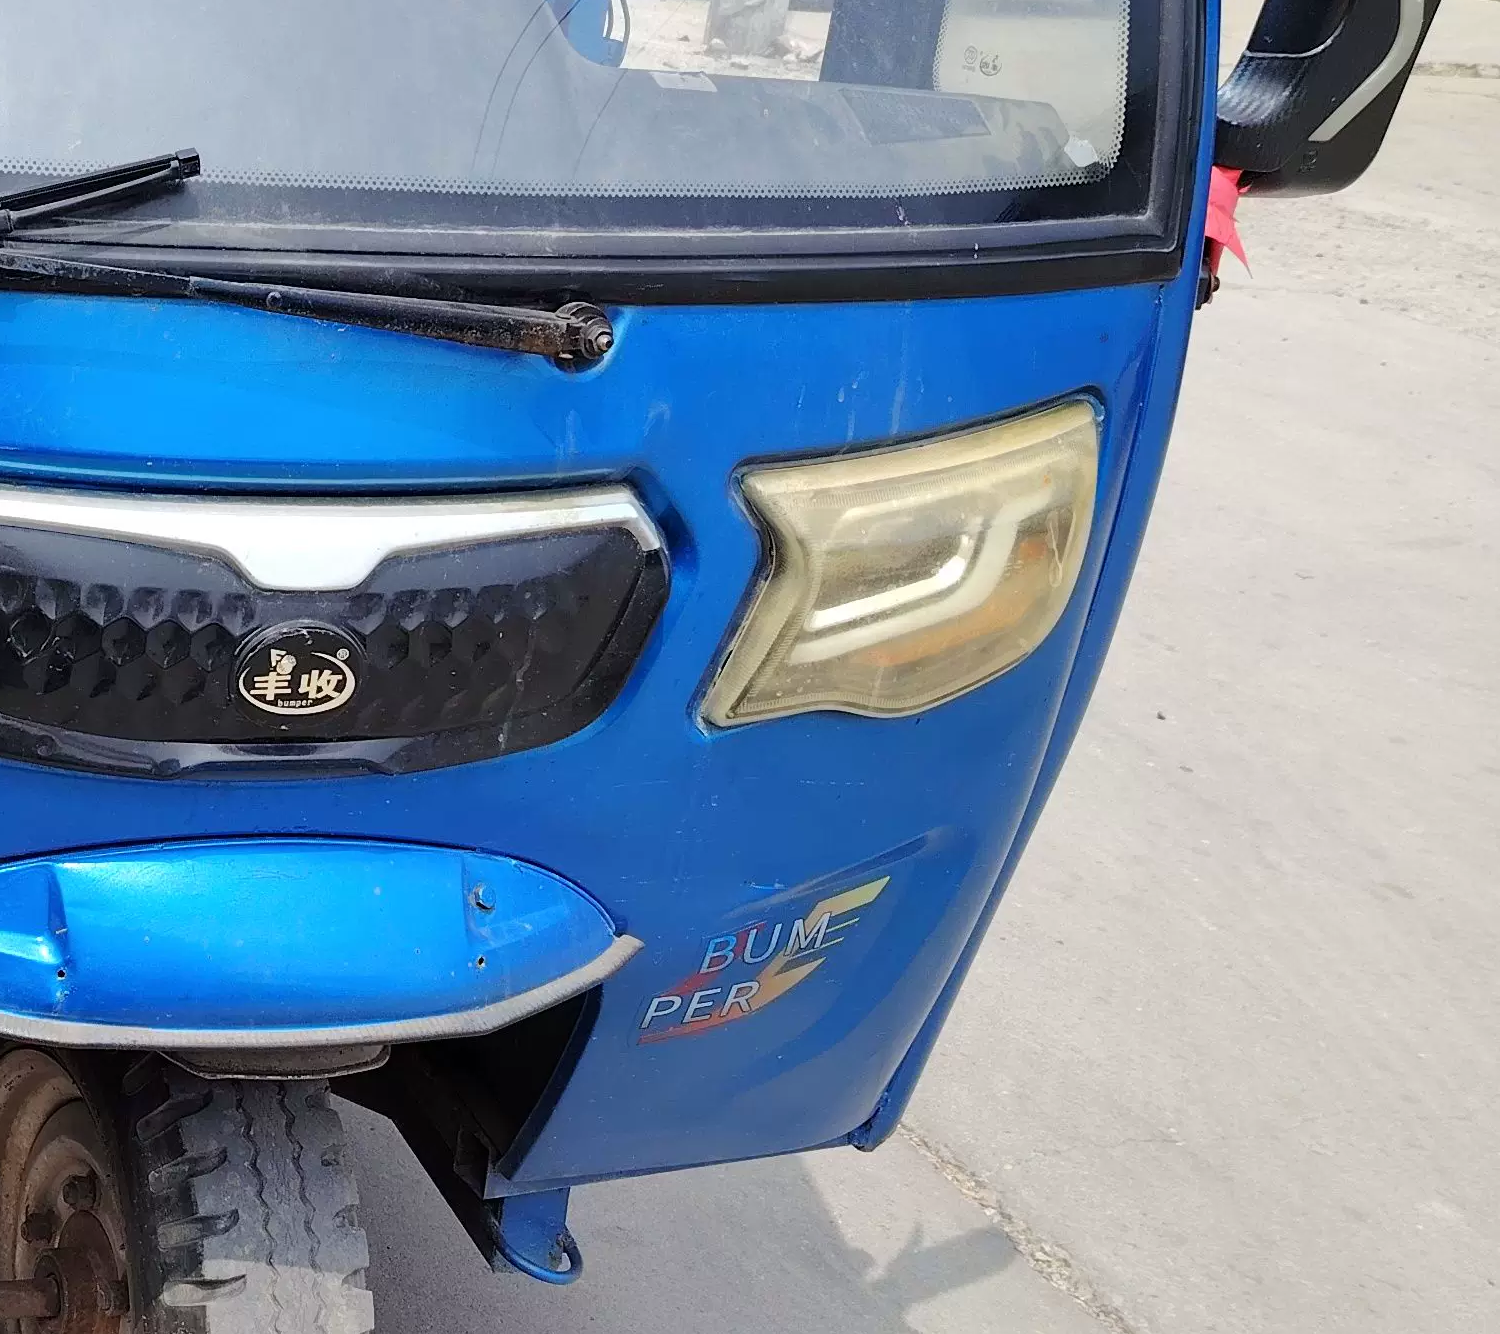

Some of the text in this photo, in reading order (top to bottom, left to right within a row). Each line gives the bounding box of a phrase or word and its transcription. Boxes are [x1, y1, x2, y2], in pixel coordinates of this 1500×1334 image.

[249, 670, 342, 701] 丰收
[277, 699, 313, 707] bumper
[698, 912, 832, 974] BUM
[638, 980, 761, 1030] PER
